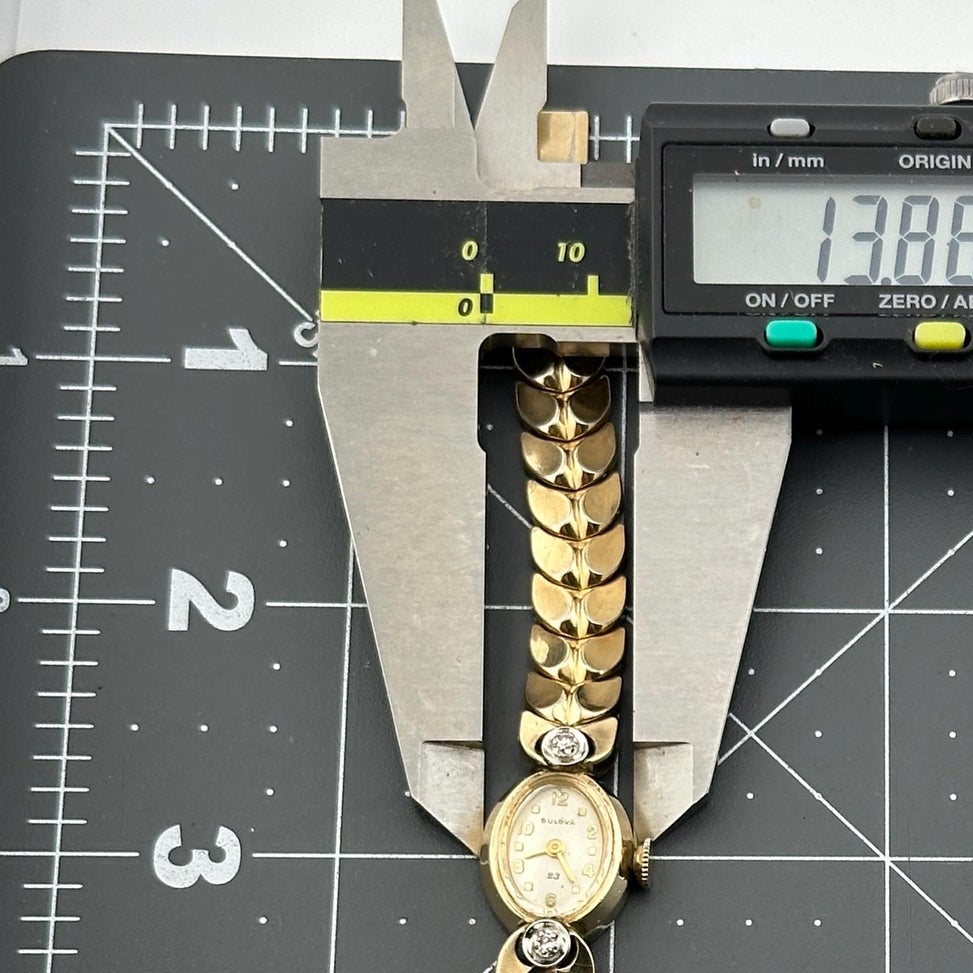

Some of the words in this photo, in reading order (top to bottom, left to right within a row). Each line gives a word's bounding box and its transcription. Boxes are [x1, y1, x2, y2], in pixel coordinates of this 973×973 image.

[752, 152, 770, 168] in
[787, 156, 825, 168] mm
[898, 153, 972, 169] ORIGIN
[461, 240, 479, 261] 0
[557, 242, 586, 263] 10
[457, 297, 474, 317] 0
[745, 292, 776, 308] ON
[791, 293, 835, 308] OFF
[878, 293, 937, 309] ZERO
[183, 327, 268, 371] 1
[167, 568, 255, 632] 2
[552, 791, 569, 806] 12
[518, 820, 534, 836] 10
[541, 817, 575, 825] BULOVA
[587, 825, 599, 840] 2
[152, 824, 241, 888] 3
[546, 872, 561, 880] 23
[582, 863, 596, 878] 4
[545, 892, 557, 907] 6
